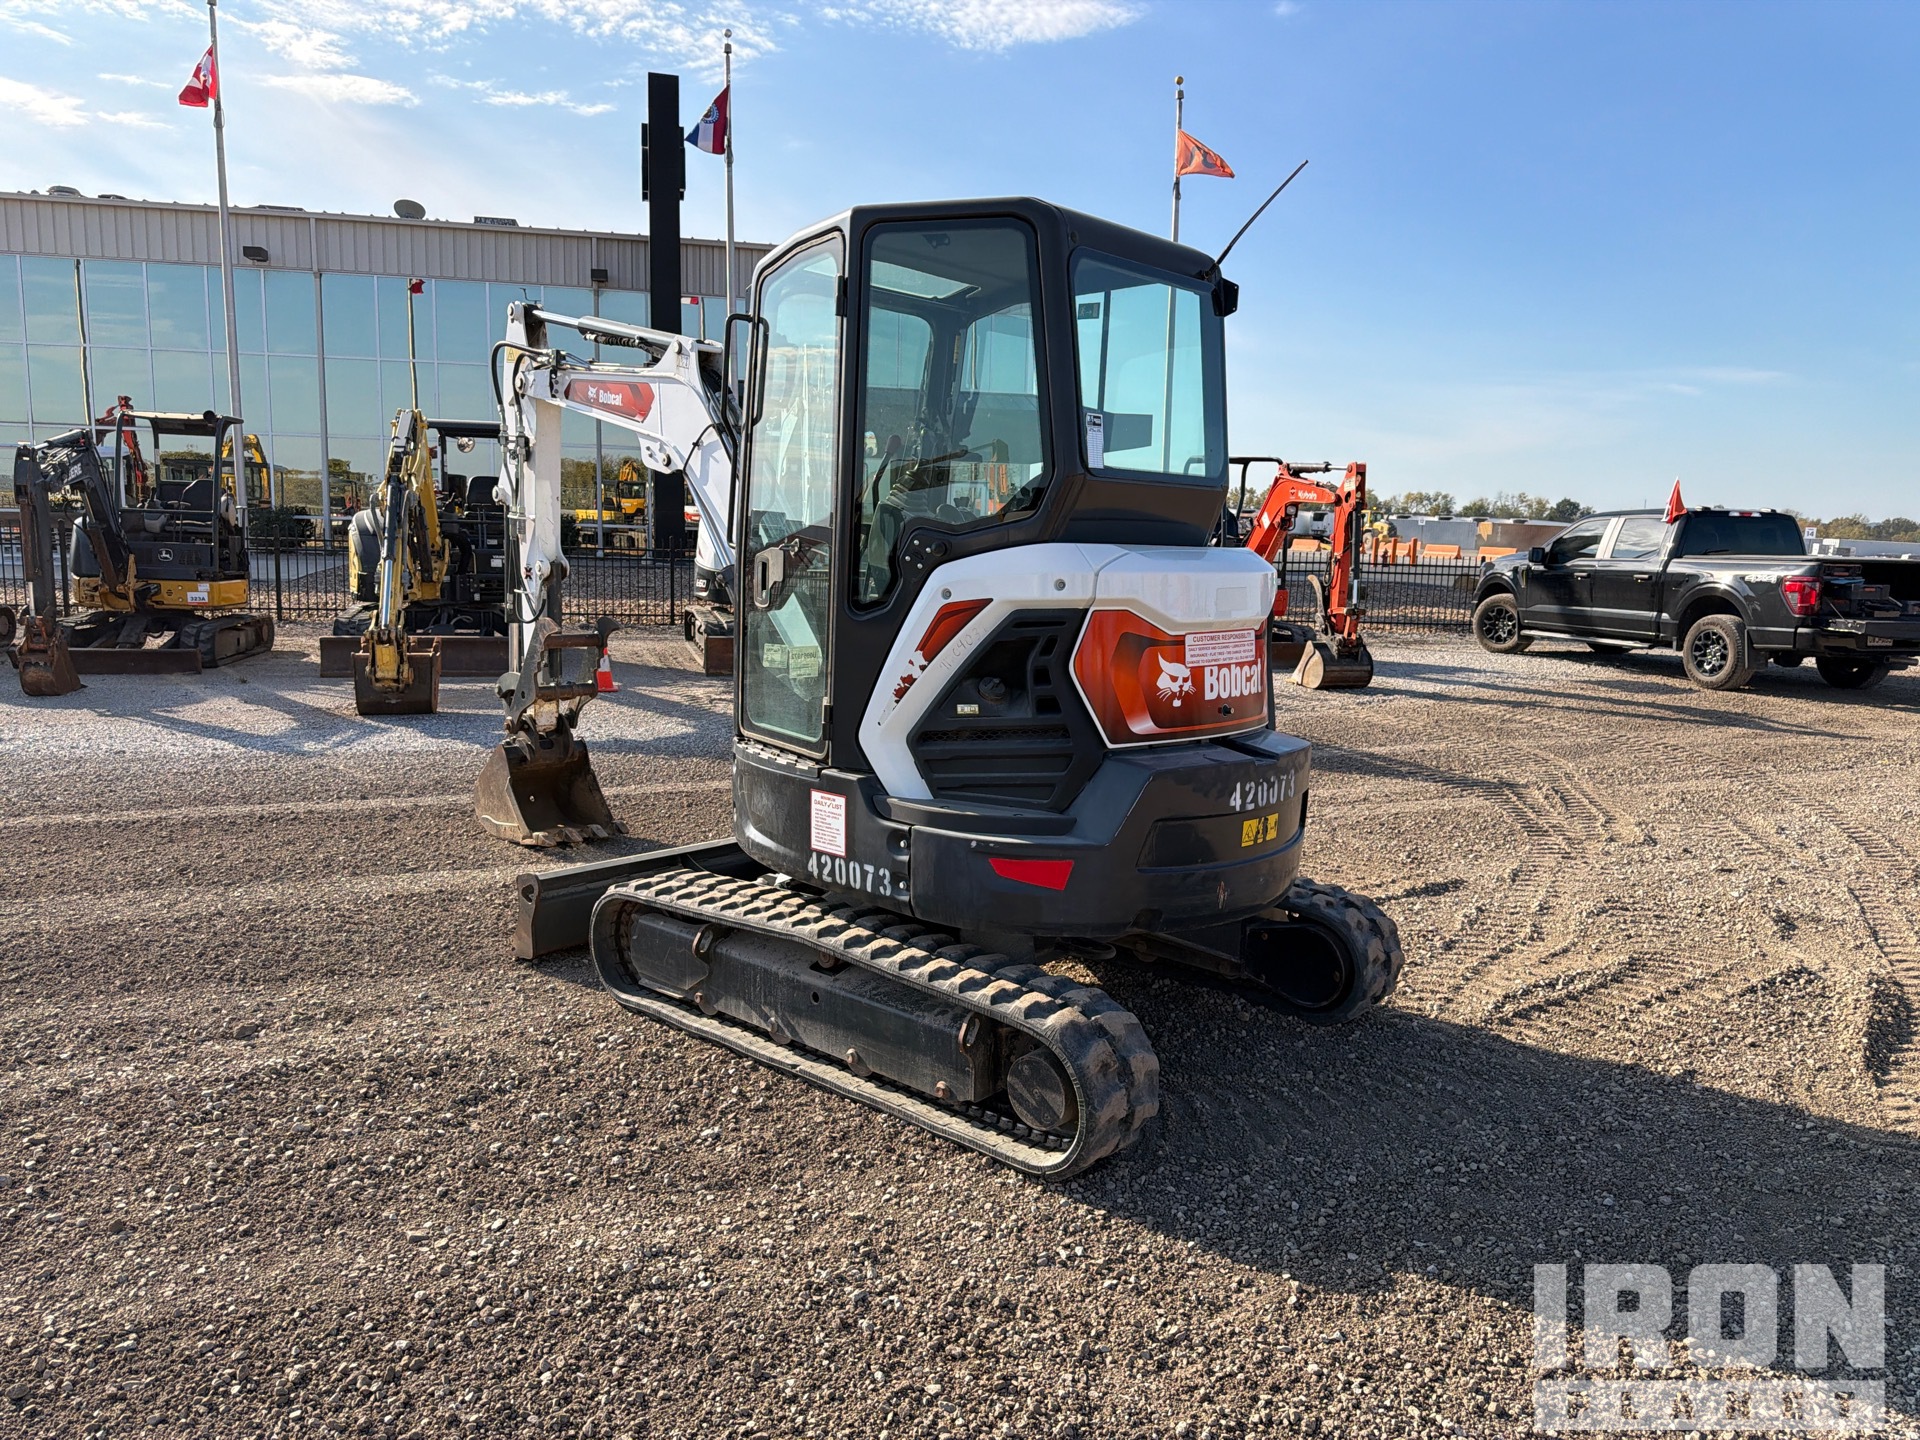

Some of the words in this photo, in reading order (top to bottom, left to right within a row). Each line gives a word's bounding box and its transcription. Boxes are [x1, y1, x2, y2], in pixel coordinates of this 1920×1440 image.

[599, 389, 623, 406] Bobcat
[1298, 489, 1318, 500] Kubota
[1193, 634, 1221, 643] CUSTOMER
[1204, 659, 1262, 701] Bobcat
[1229, 769, 1295, 812] 420073
[814, 799, 828, 807] DAILY
[831, 803, 843, 811] LIST
[807, 851, 892, 897] 420073
